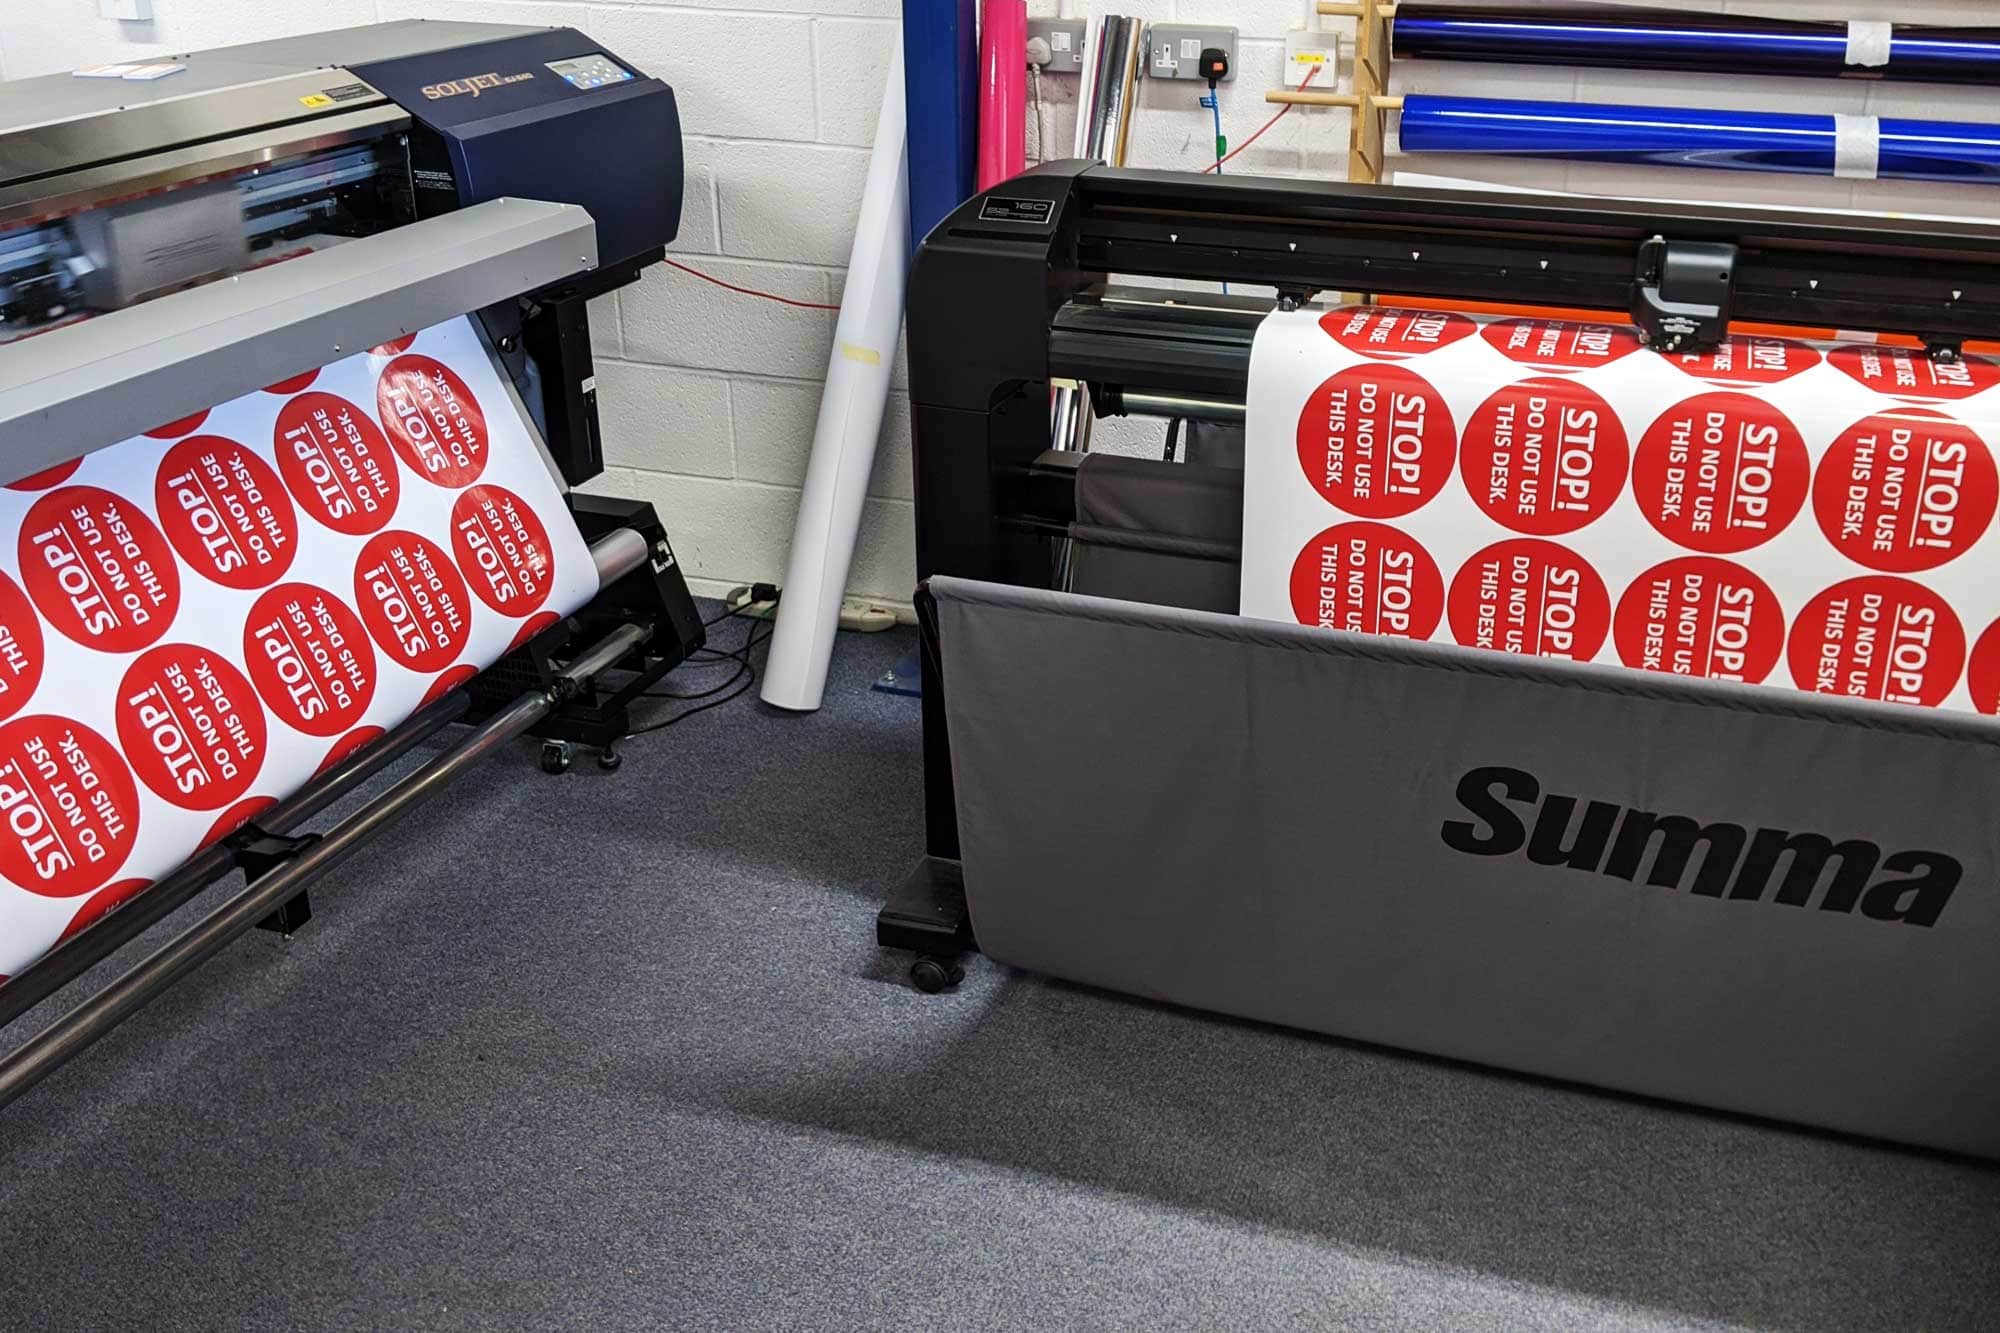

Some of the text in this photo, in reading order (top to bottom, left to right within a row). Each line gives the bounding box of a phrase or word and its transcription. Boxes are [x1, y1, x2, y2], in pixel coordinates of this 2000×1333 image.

[421, 73, 501, 99] SOLJET
[314, 409, 377, 512] DO NOT USE
[338, 408, 389, 497] THIS DESK.
[388, 386, 446, 472] STOP!
[413, 370, 470, 468] DO NOT USE
[433, 369, 480, 454] THIS DESK.
[1326, 390, 1347, 487] THIS DESK.
[1354, 383, 1377, 498] DO NOT USE
[1390, 394, 1425, 494] STOP!
[1490, 404, 1514, 503] THIS DESK.
[1519, 397, 1546, 514] DO NOT USE
[1558, 408, 1597, 510] STOP!
[201, 454, 272, 564] DO NOT USE
[229, 452, 286, 548] THIS DESK.
[285, 426, 352, 518] STOP!
[1662, 419, 1692, 520] THIS DESK.
[1692, 412, 1725, 532] DO NOT USE
[1734, 424, 1778, 528] STOP!
[1842, 435, 1877, 540] THIS DESK.
[1873, 429, 1912, 551] DO NOT USE
[1916, 441, 1966, 547] STOP!
[72, 506, 149, 624] DO NOT USE
[103, 503, 166, 606] THIS DESK.
[168, 474, 242, 572] STOP!
[459, 518, 514, 602] STOP!
[481, 500, 535, 594] DO NOT USE
[502, 498, 546, 580] THIS DESK.
[33, 528, 114, 635] STOP!
[364, 566, 425, 656] STOP!
[391, 547, 450, 648] DO NOT USE
[414, 544, 461, 632] THIS DESK.
[1319, 544, 1337, 629] THIS DESK
[1346, 540, 1366, 632] DO NOT US
[1476, 562, 1499, 648] THIS DESK
[1505, 557, 1529, 653] DO NOT US
[1542, 567, 1580, 660] STOP!
[1650, 580, 1670, 618] THIS
[1673, 575, 1702, 674] DO NOT US
[1825, 599, 1848, 638] THIS
[256, 622, 324, 720] STOP!
[286, 601, 351, 708] DO NOT USE
[312, 597, 365, 690] THIS DESK.
[1712, 586, 1754, 682] STOP!
[1848, 594, 1882, 696] DO NOT US
[1886, 606, 1934, 704] STOP!
[130, 688, 204, 793] STOP!
[165, 663, 237, 779] DO NOT USE
[194, 658, 254, 759] THIS DESK.
[24, 736, 105, 862] DO NOT USE
[59, 730, 124, 839] THIS DESK.
[1441, 766, 1963, 928] Summa
